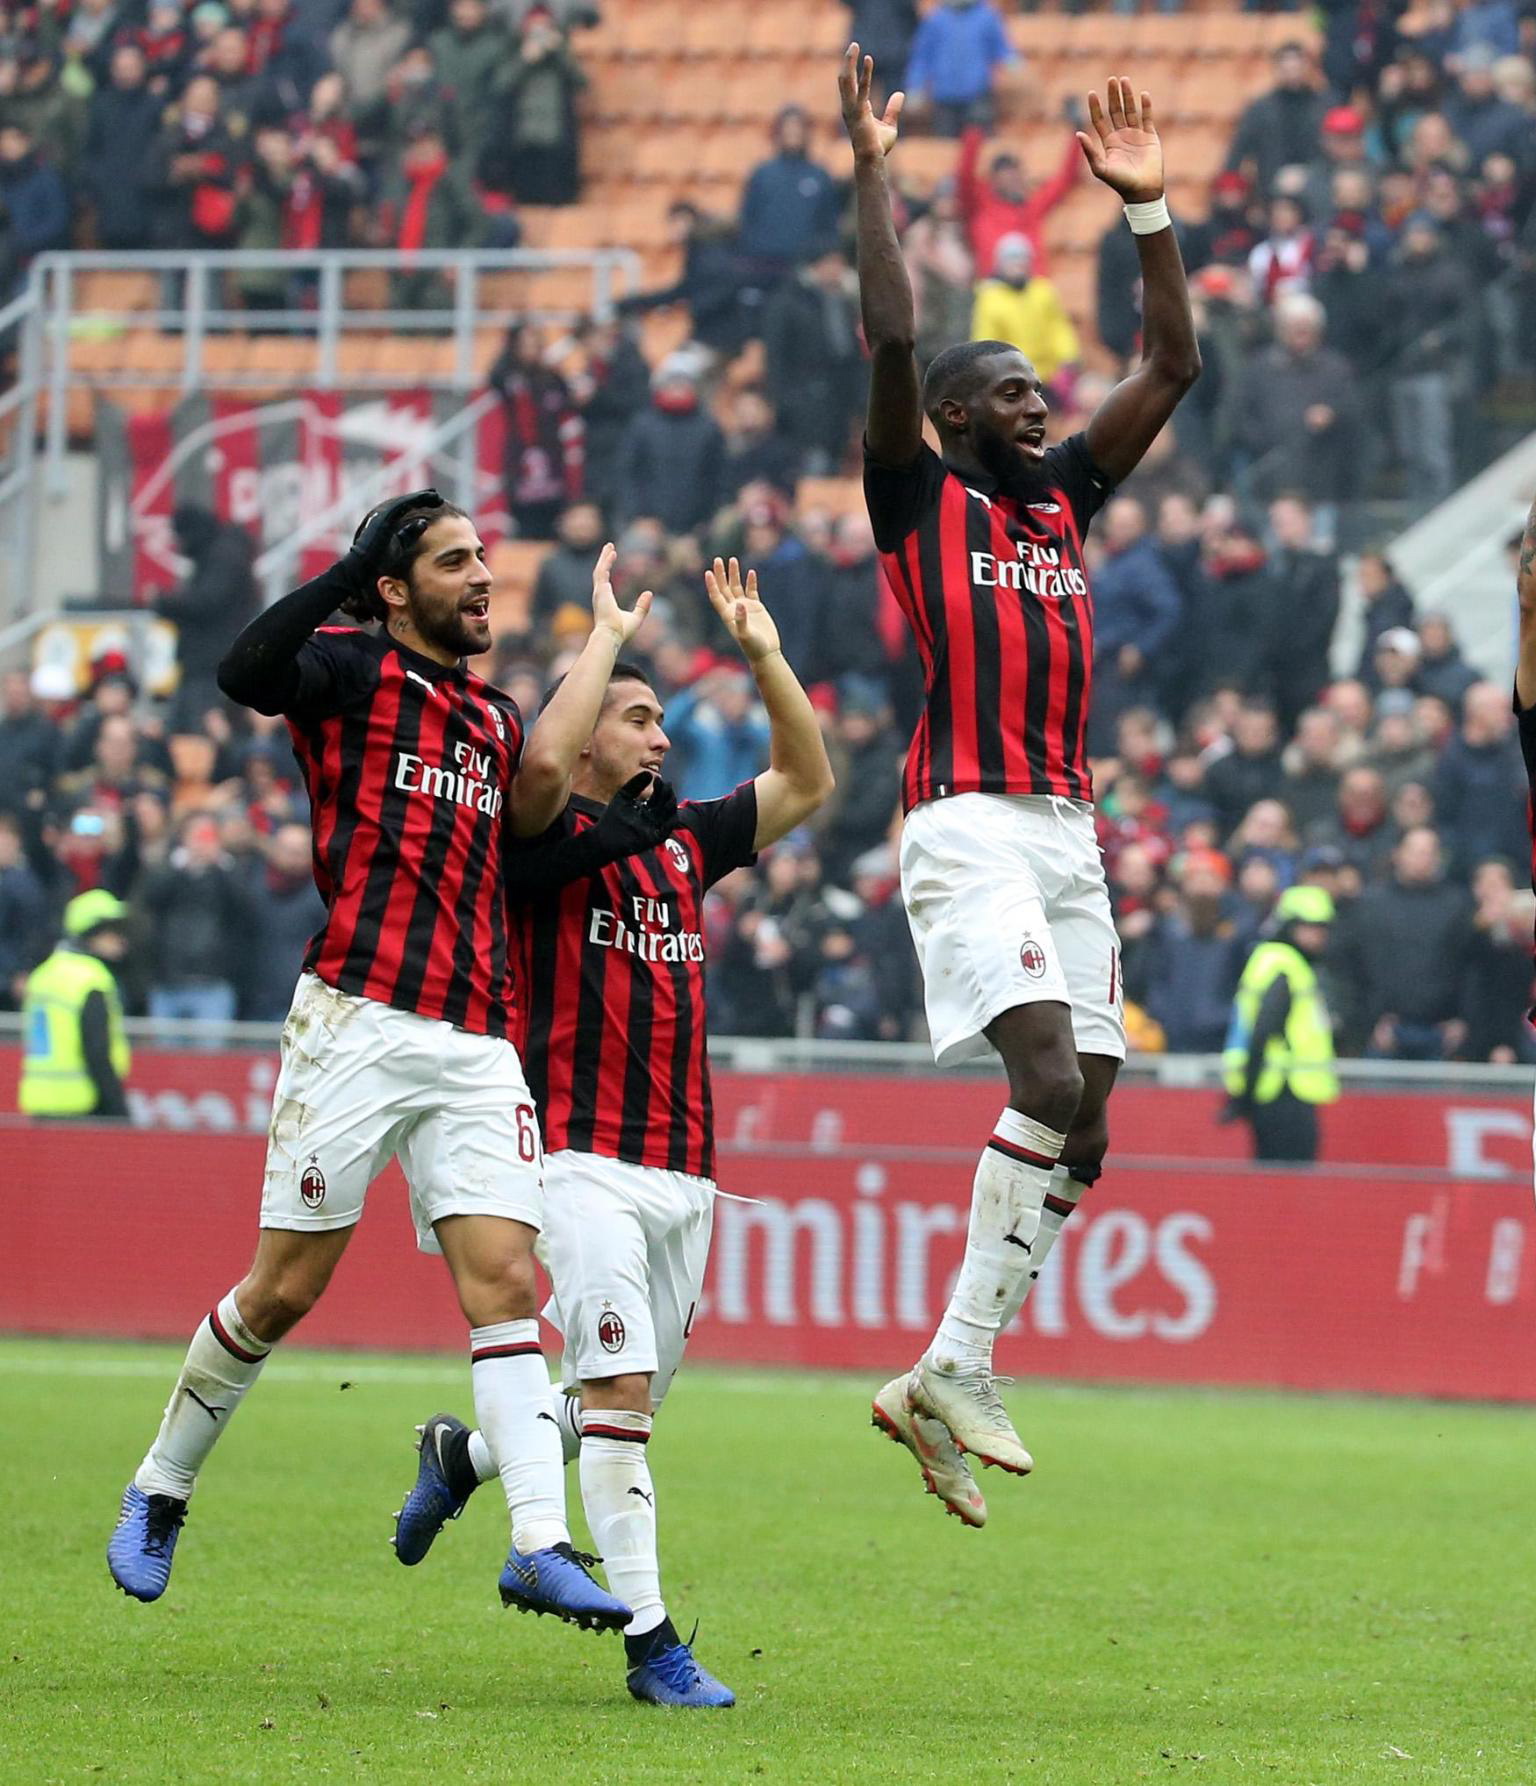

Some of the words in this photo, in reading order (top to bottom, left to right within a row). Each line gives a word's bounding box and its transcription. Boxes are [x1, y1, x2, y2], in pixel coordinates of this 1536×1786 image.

[970, 551, 1087, 597] Emirates
[1016, 541, 1060, 566] Fly
[454, 740, 491, 779] Fly
[395, 752, 502, 820] Emirat
[632, 896, 669, 928] Fly
[516, 1103, 541, 1165] 6
[700, 1164, 1216, 1341] mirtes
